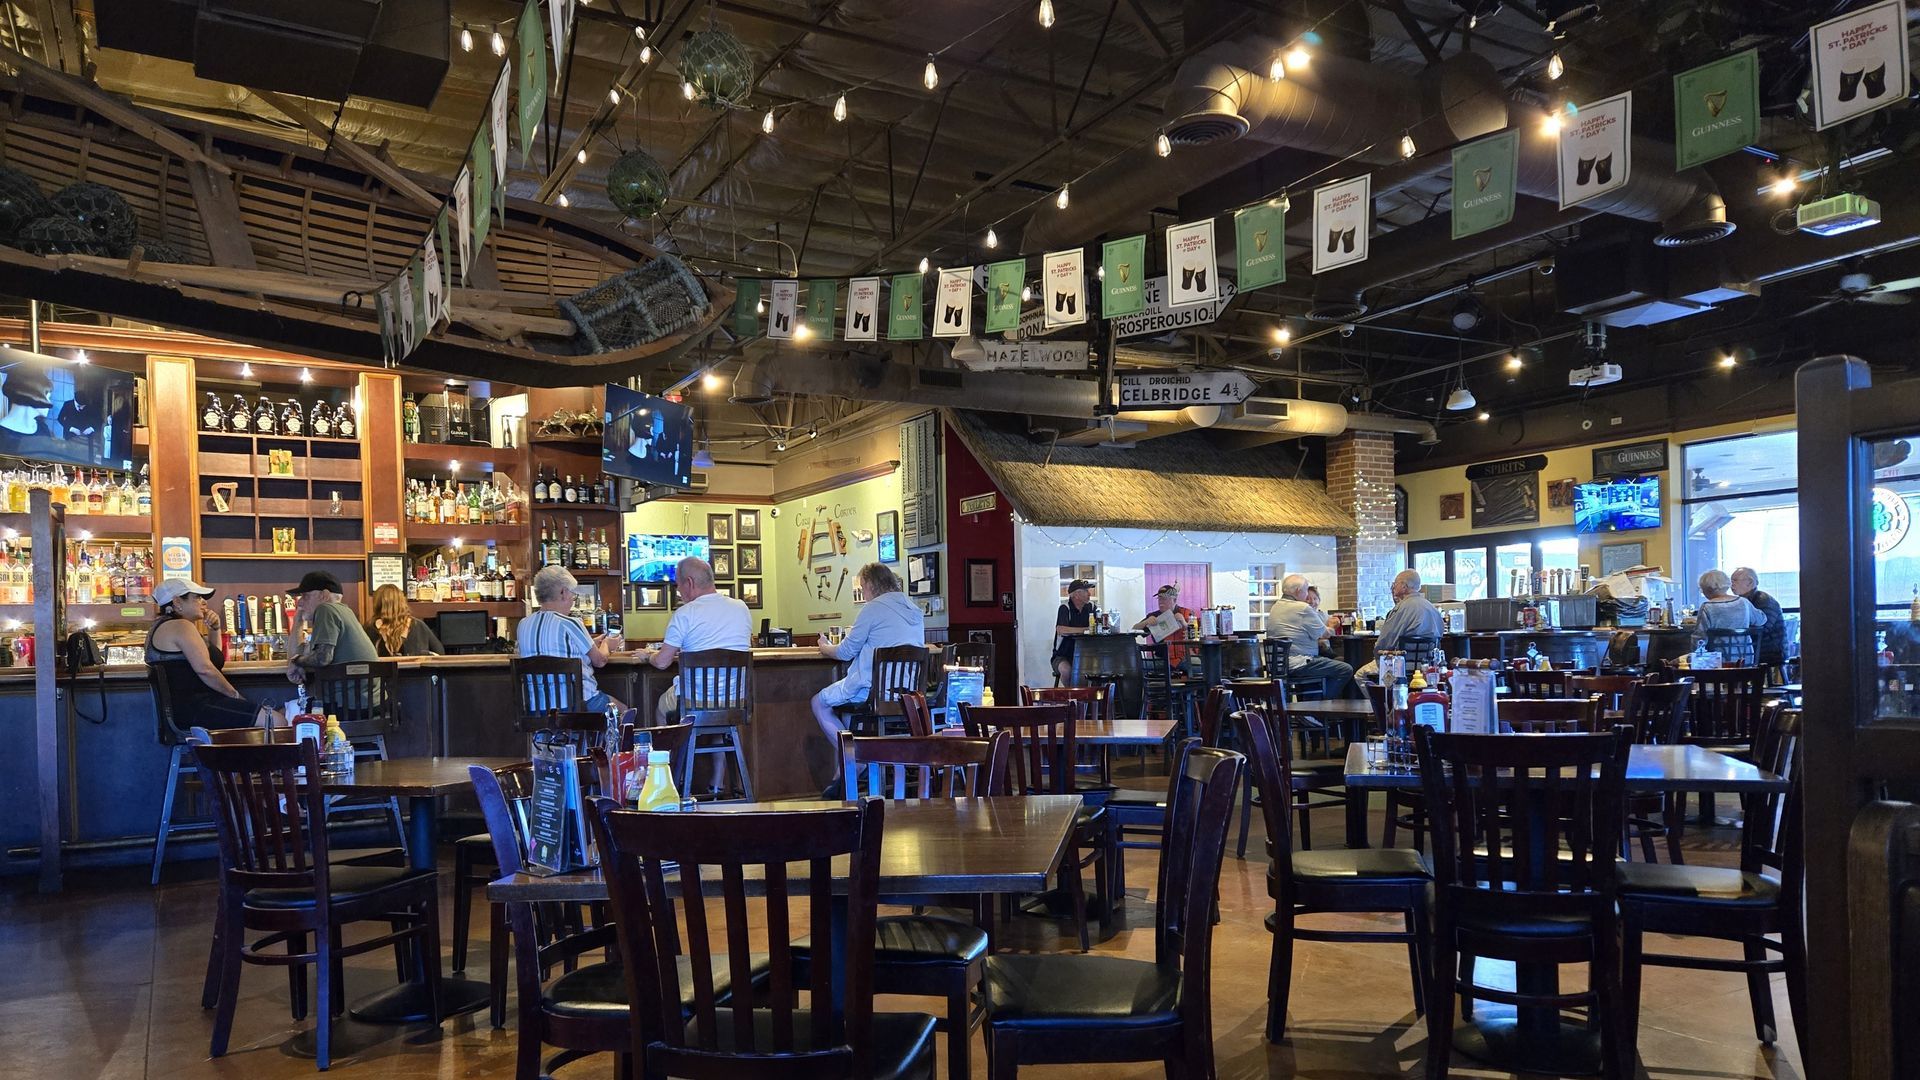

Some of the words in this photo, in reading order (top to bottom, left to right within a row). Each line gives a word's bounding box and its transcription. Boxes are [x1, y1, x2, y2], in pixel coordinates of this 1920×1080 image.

[1841, 22, 1873, 38] HAPPY
[1828, 40, 1841, 49] ST.
[1842, 25, 1888, 45] PATRICKS
[1849, 39, 1867, 50] DAY
[1580, 114, 1606, 127] HAPPY
[1692, 115, 1742, 137] GUINNESS
[1569, 129, 1581, 138] ST.
[1580, 117, 1617, 133] PATRICKS
[1586, 129, 1600, 139] DAY
[1332, 192, 1352, 202] HAPPY
[1333, 195, 1359, 208] PATRICKS
[1463, 192, 1504, 209] GUINNESS
[1336, 205, 1348, 213] DAY
[1183, 239, 1207, 248] PATRICKS
[1245, 253, 1276, 267] GUINNESS
[1111, 285, 1137, 295] GUINNESS
[993, 303, 1014, 312] GUINNESS
[986, 349, 1085, 363] HAZELWOOD
[1122, 377, 1141, 386] CILL
[1149, 376, 1191, 385] DROICHID
[1122, 388, 1211, 402] CELBRIDGE
[1618, 449, 1661, 463] GUINNESS
[1485, 461, 1526, 475] SPIRITS
